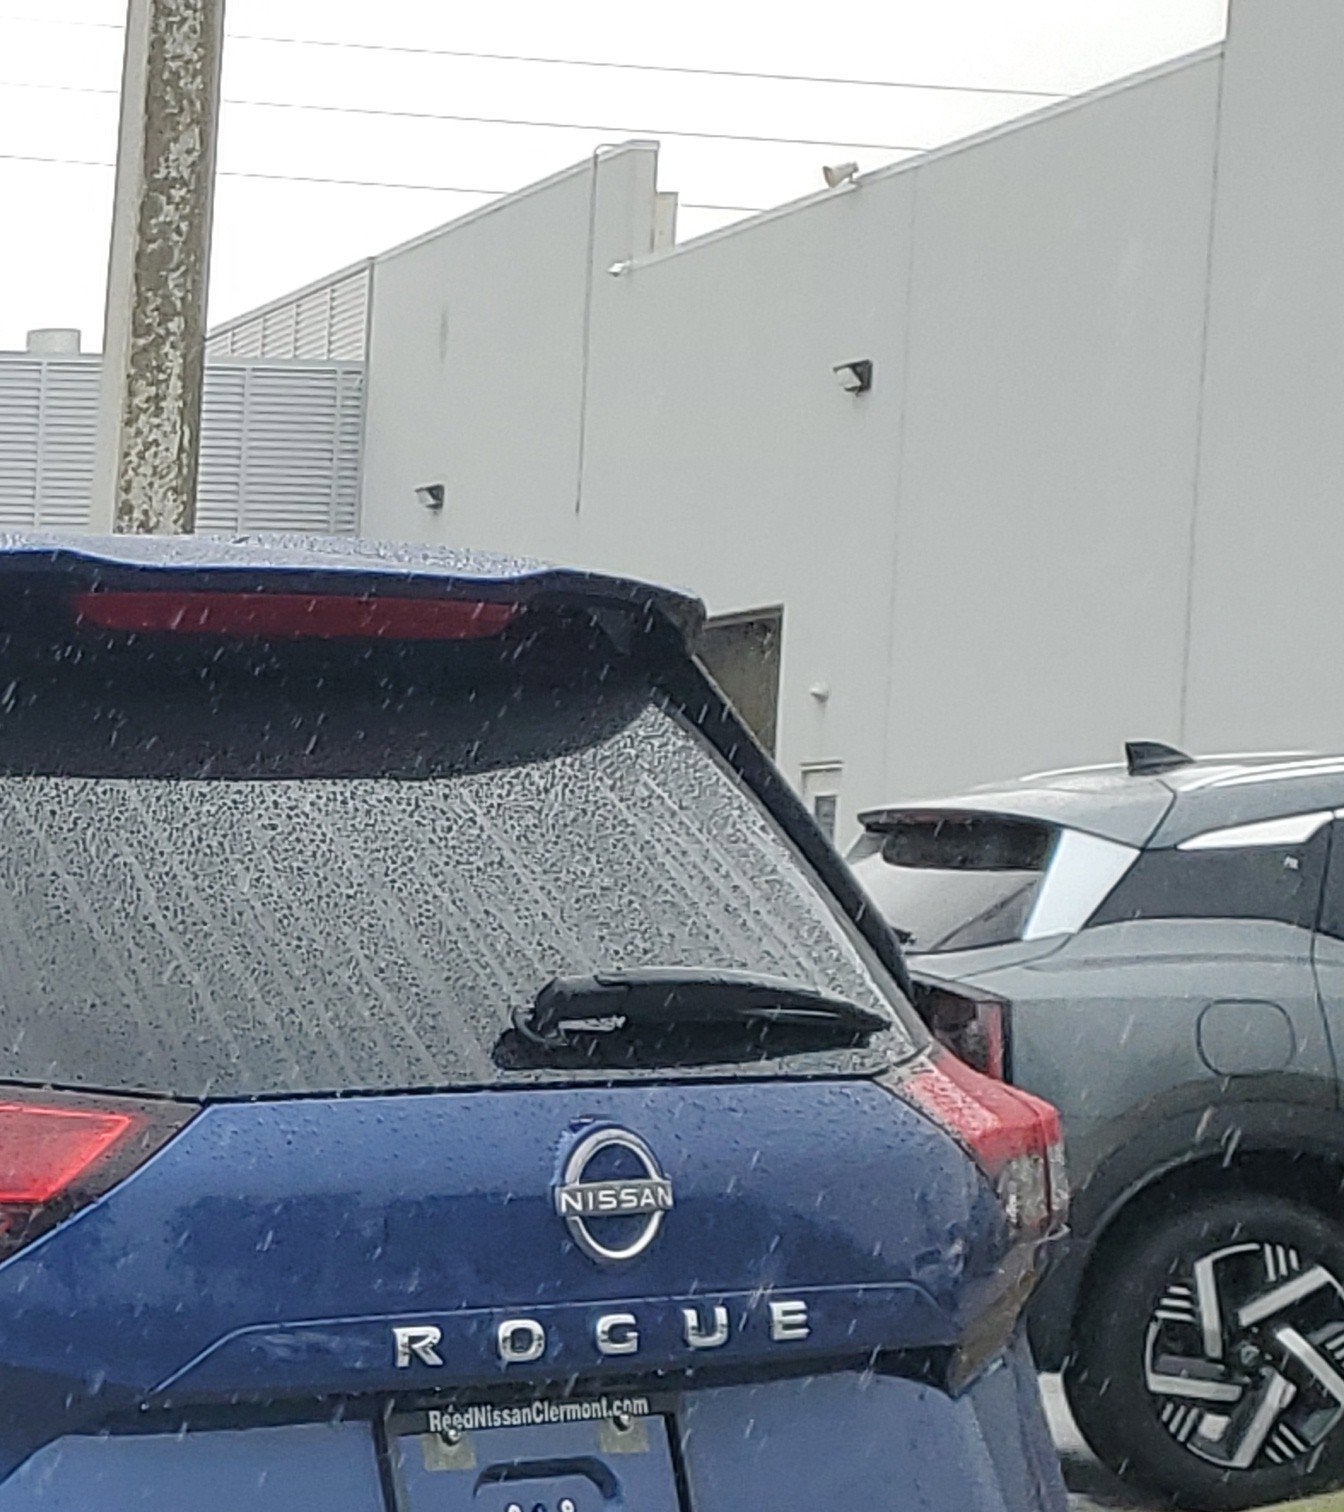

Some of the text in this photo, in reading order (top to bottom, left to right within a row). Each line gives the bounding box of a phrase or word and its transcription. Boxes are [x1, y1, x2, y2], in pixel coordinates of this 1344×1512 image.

[561, 1186, 673, 1213] NISSAN
[392, 1300, 811, 1367] ROGUE
[428, 1397, 650, 1432] ReedNissanClermont.com
